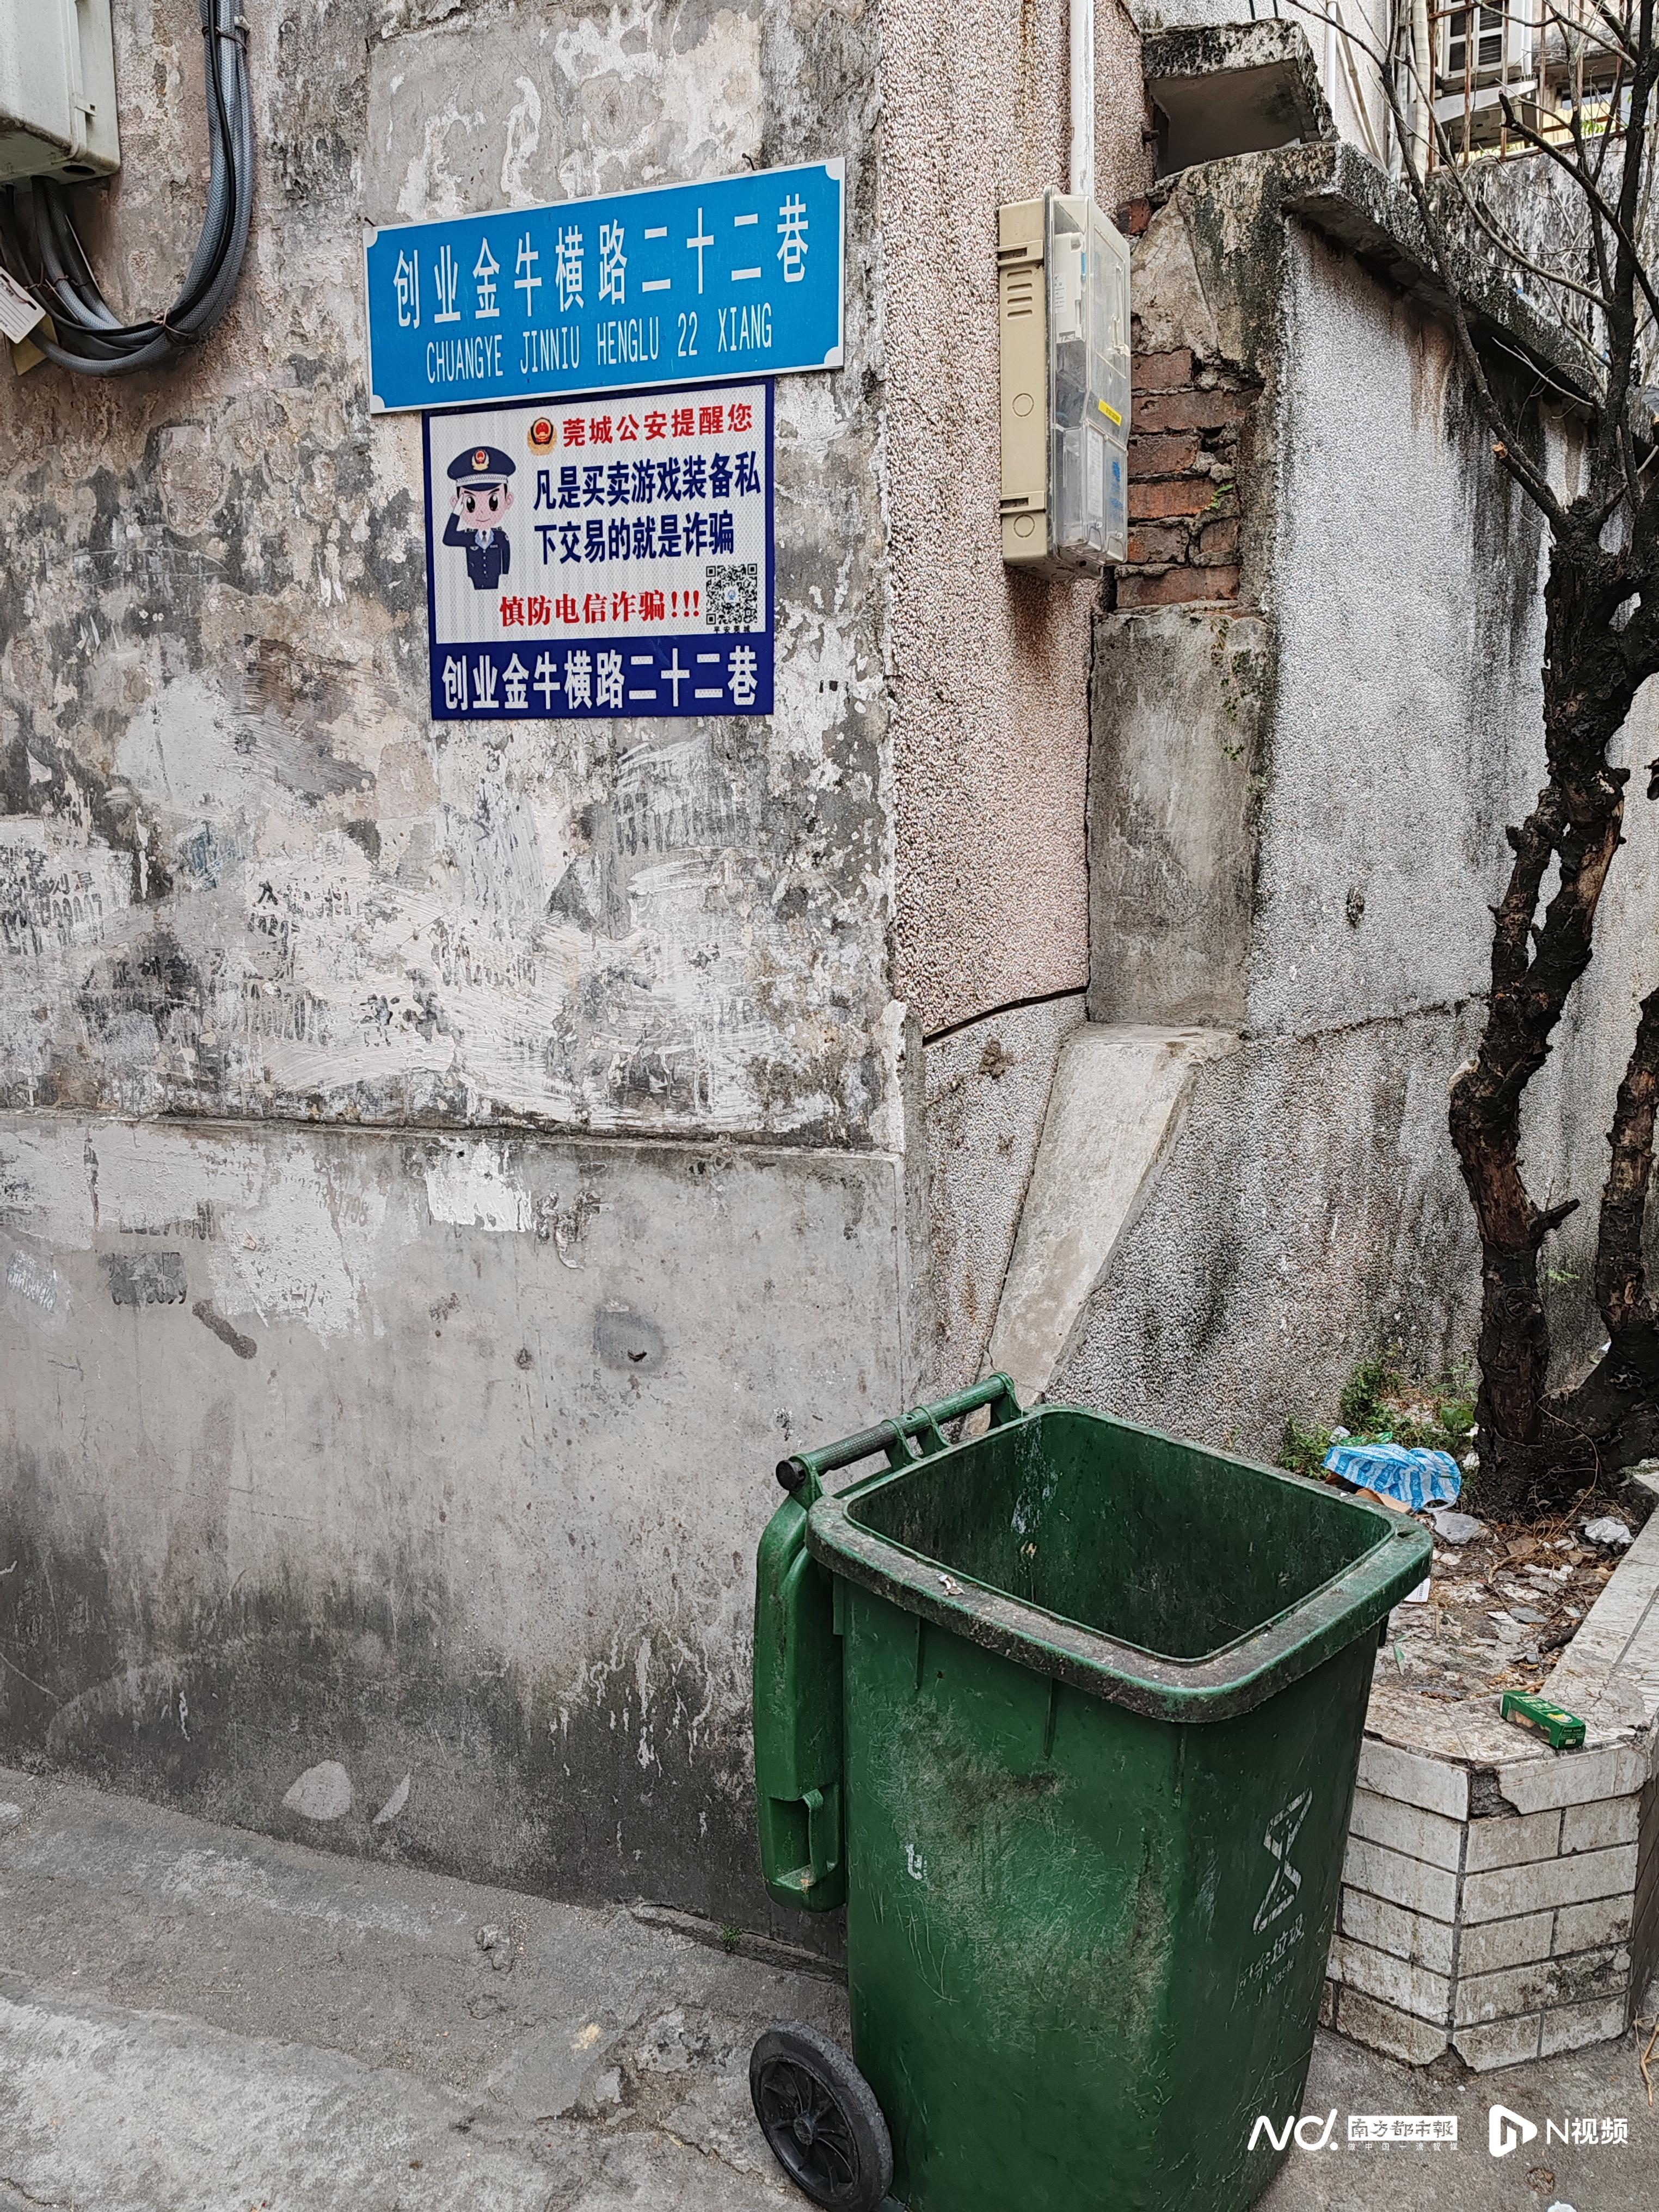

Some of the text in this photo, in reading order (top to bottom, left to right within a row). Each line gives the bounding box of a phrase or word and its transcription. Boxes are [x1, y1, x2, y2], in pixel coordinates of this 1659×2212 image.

[393, 193, 809, 329] 创业金牛横路二十二巷
[426, 302, 772, 384] CHUANGYE JINNIU HENGLU 22 XIANG
[562, 402, 753, 447] 莞城公安提醒您
[533, 450, 761, 512] 凡是买卖游戏装备私
[534, 509, 734, 565] 下交易的就是诈骗
[714, 625, 751, 634] 平安莞城
[441, 645, 759, 711] 创业金牛横路二十二巷
